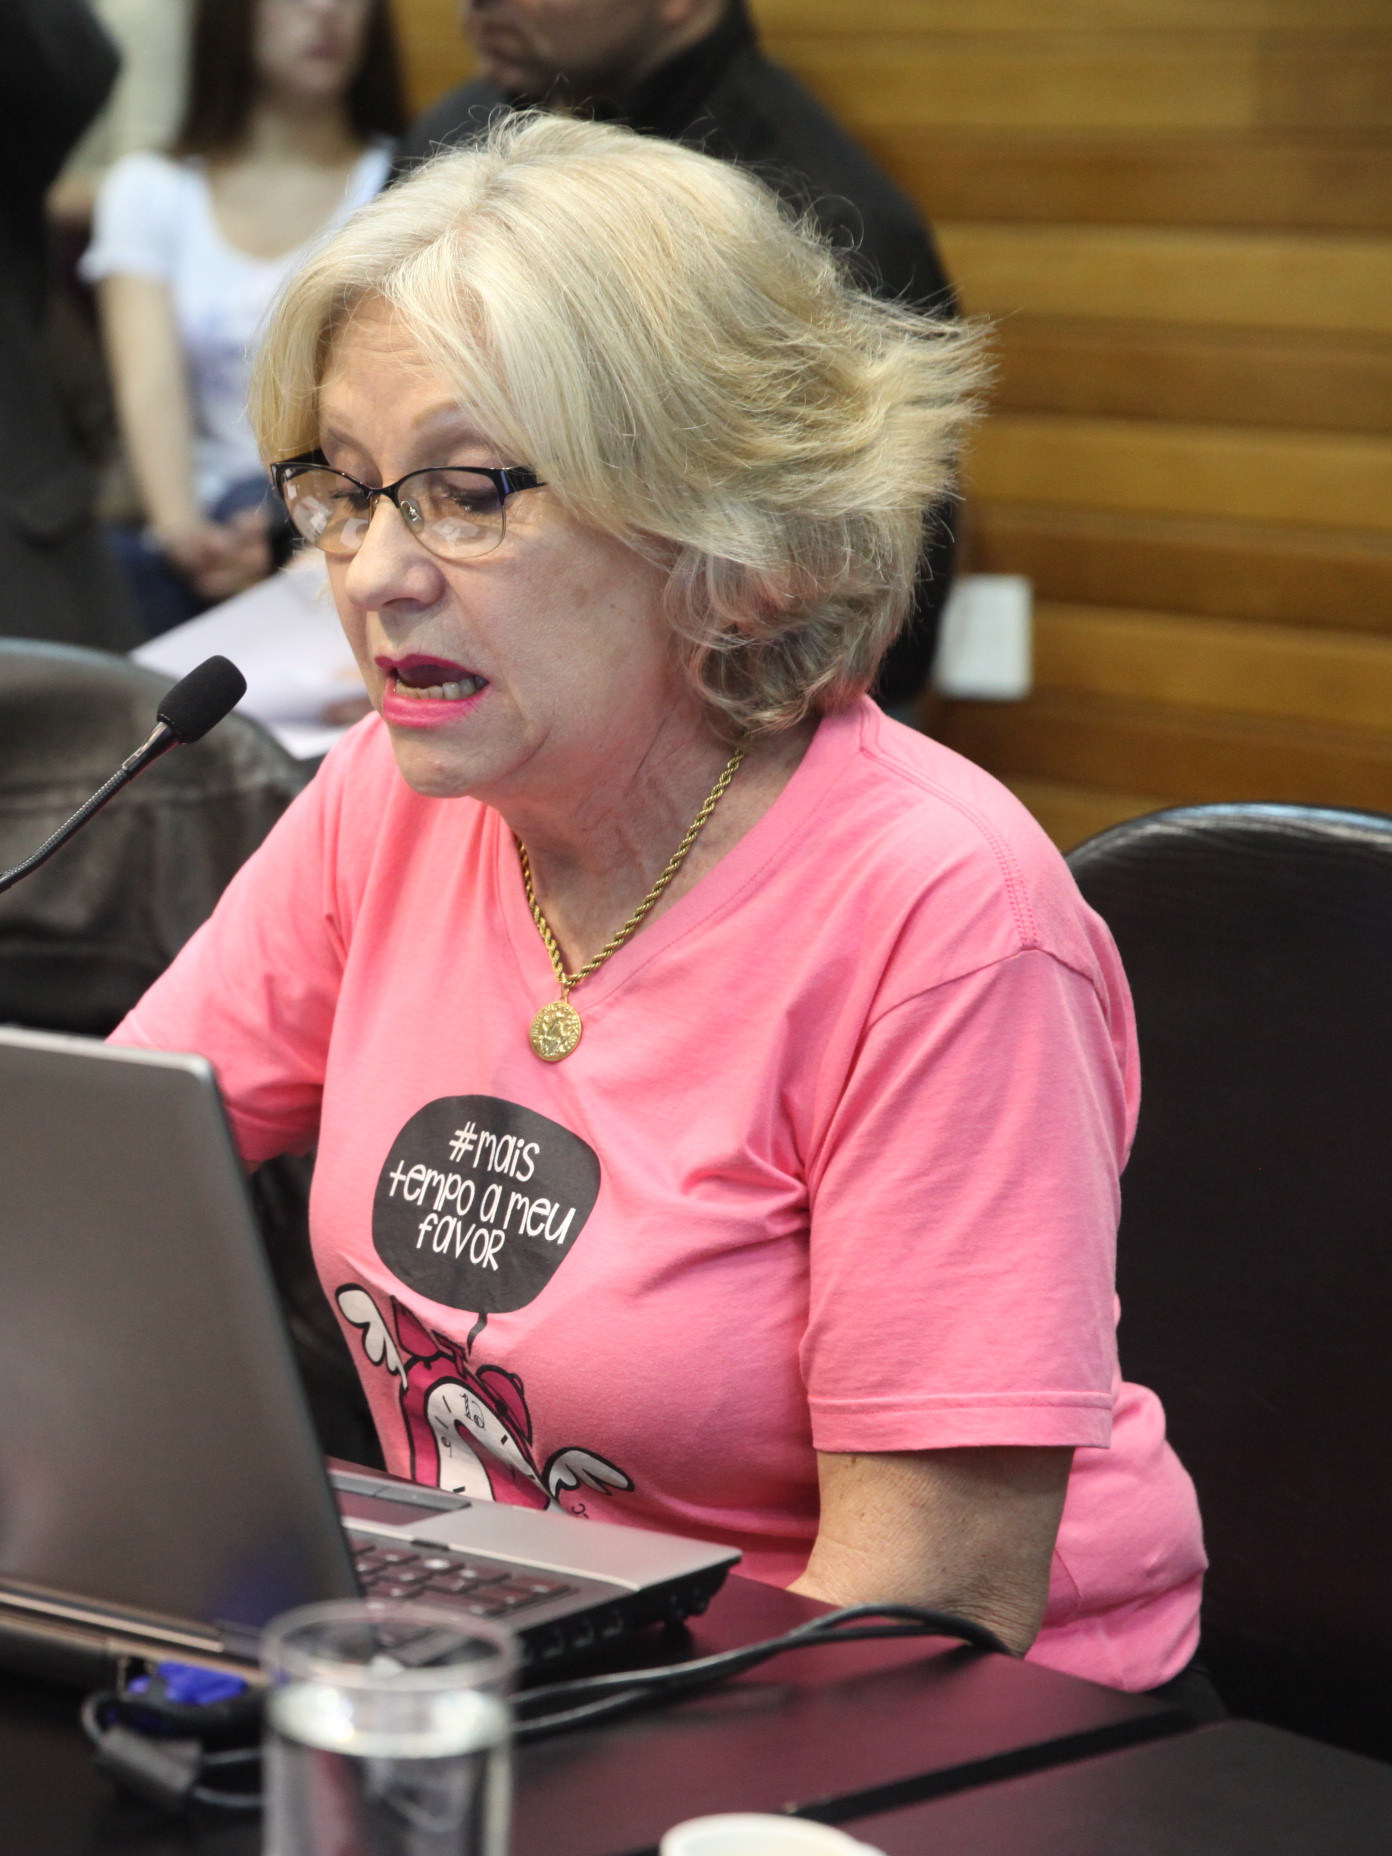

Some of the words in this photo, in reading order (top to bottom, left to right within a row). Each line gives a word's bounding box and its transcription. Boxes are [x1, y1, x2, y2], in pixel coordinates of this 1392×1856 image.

[448, 1120, 541, 1182] #mais
[388, 1159, 476, 1216] tempo
[479, 1183, 503, 1224] a
[502, 1191, 577, 1245] meu
